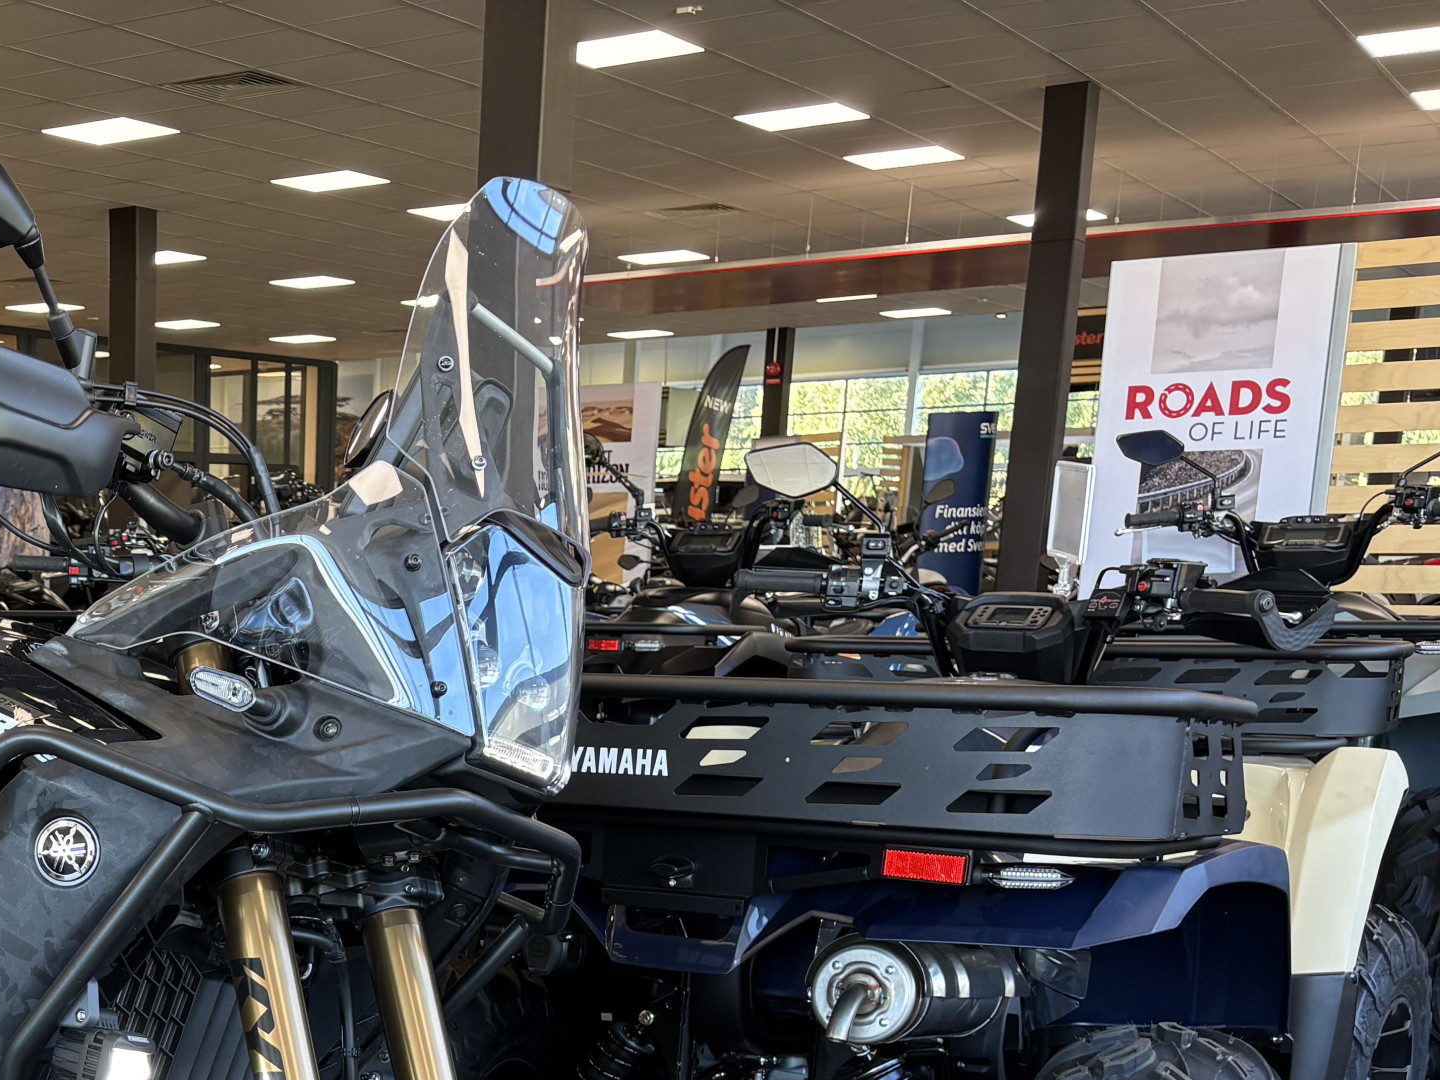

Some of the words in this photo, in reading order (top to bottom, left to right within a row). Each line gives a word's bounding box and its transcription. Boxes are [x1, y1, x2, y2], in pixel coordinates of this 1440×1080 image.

[703, 395, 732, 414] NEW
[1125, 378, 1292, 420] ROADS
[1189, 422, 1224, 442] OF
[1233, 419, 1288, 441] LIFE
[571, 746, 669, 777] YAMAHA
